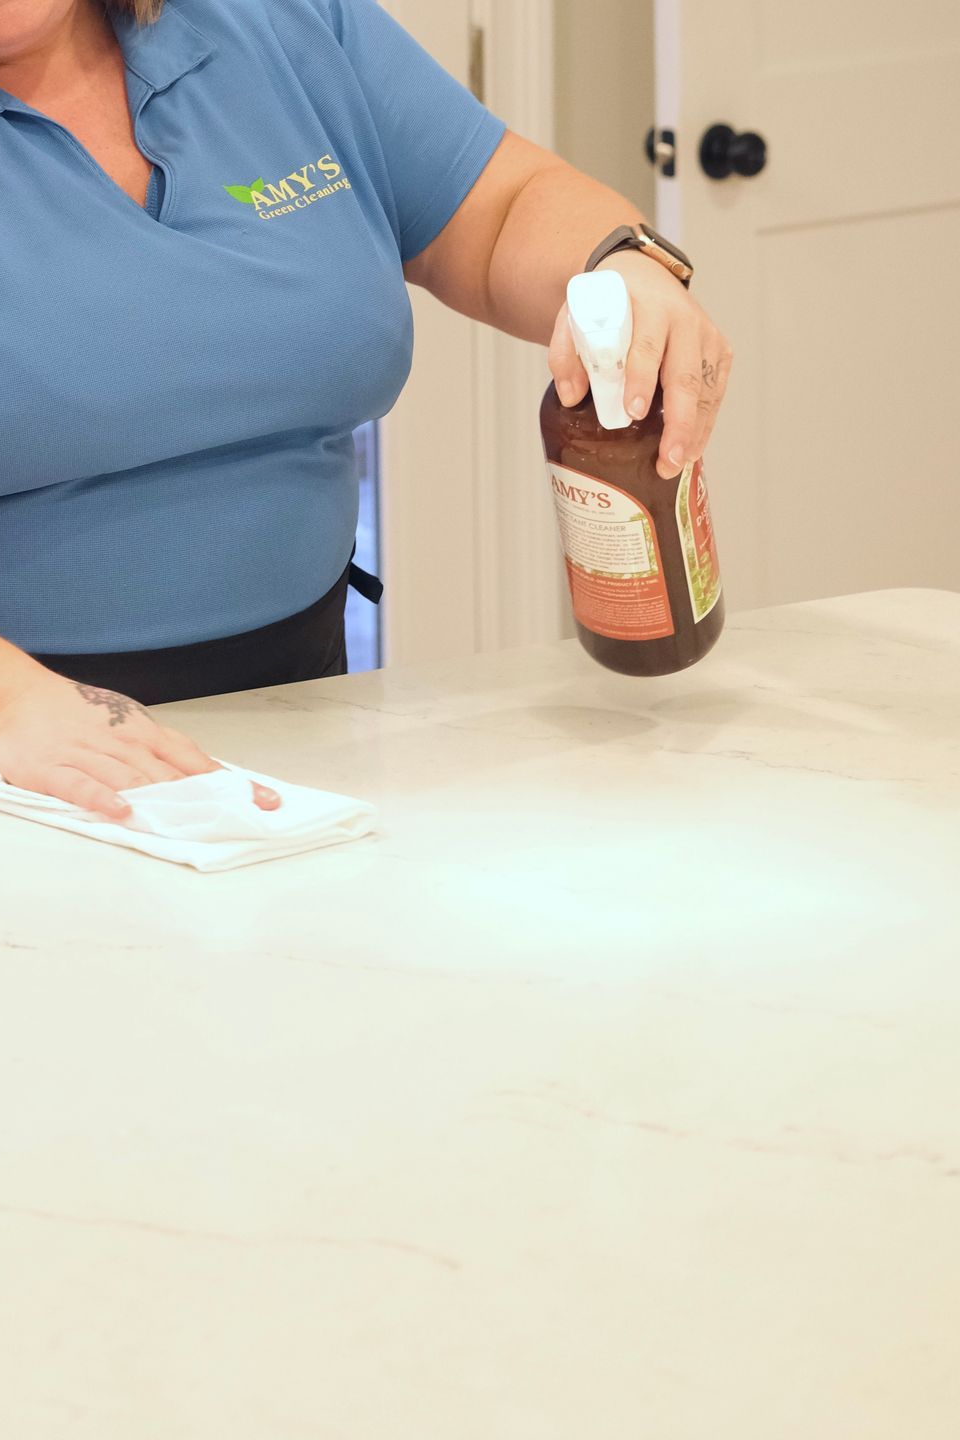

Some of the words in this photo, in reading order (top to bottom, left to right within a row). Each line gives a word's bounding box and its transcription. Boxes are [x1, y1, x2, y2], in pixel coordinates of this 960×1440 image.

[250, 154, 340, 210] AMY'S
[259, 205, 295, 220] Green
[295, 178, 351, 209] Cleaning
[552, 474, 611, 509] AMY'S
[589, 522, 626, 532] CLEANER
